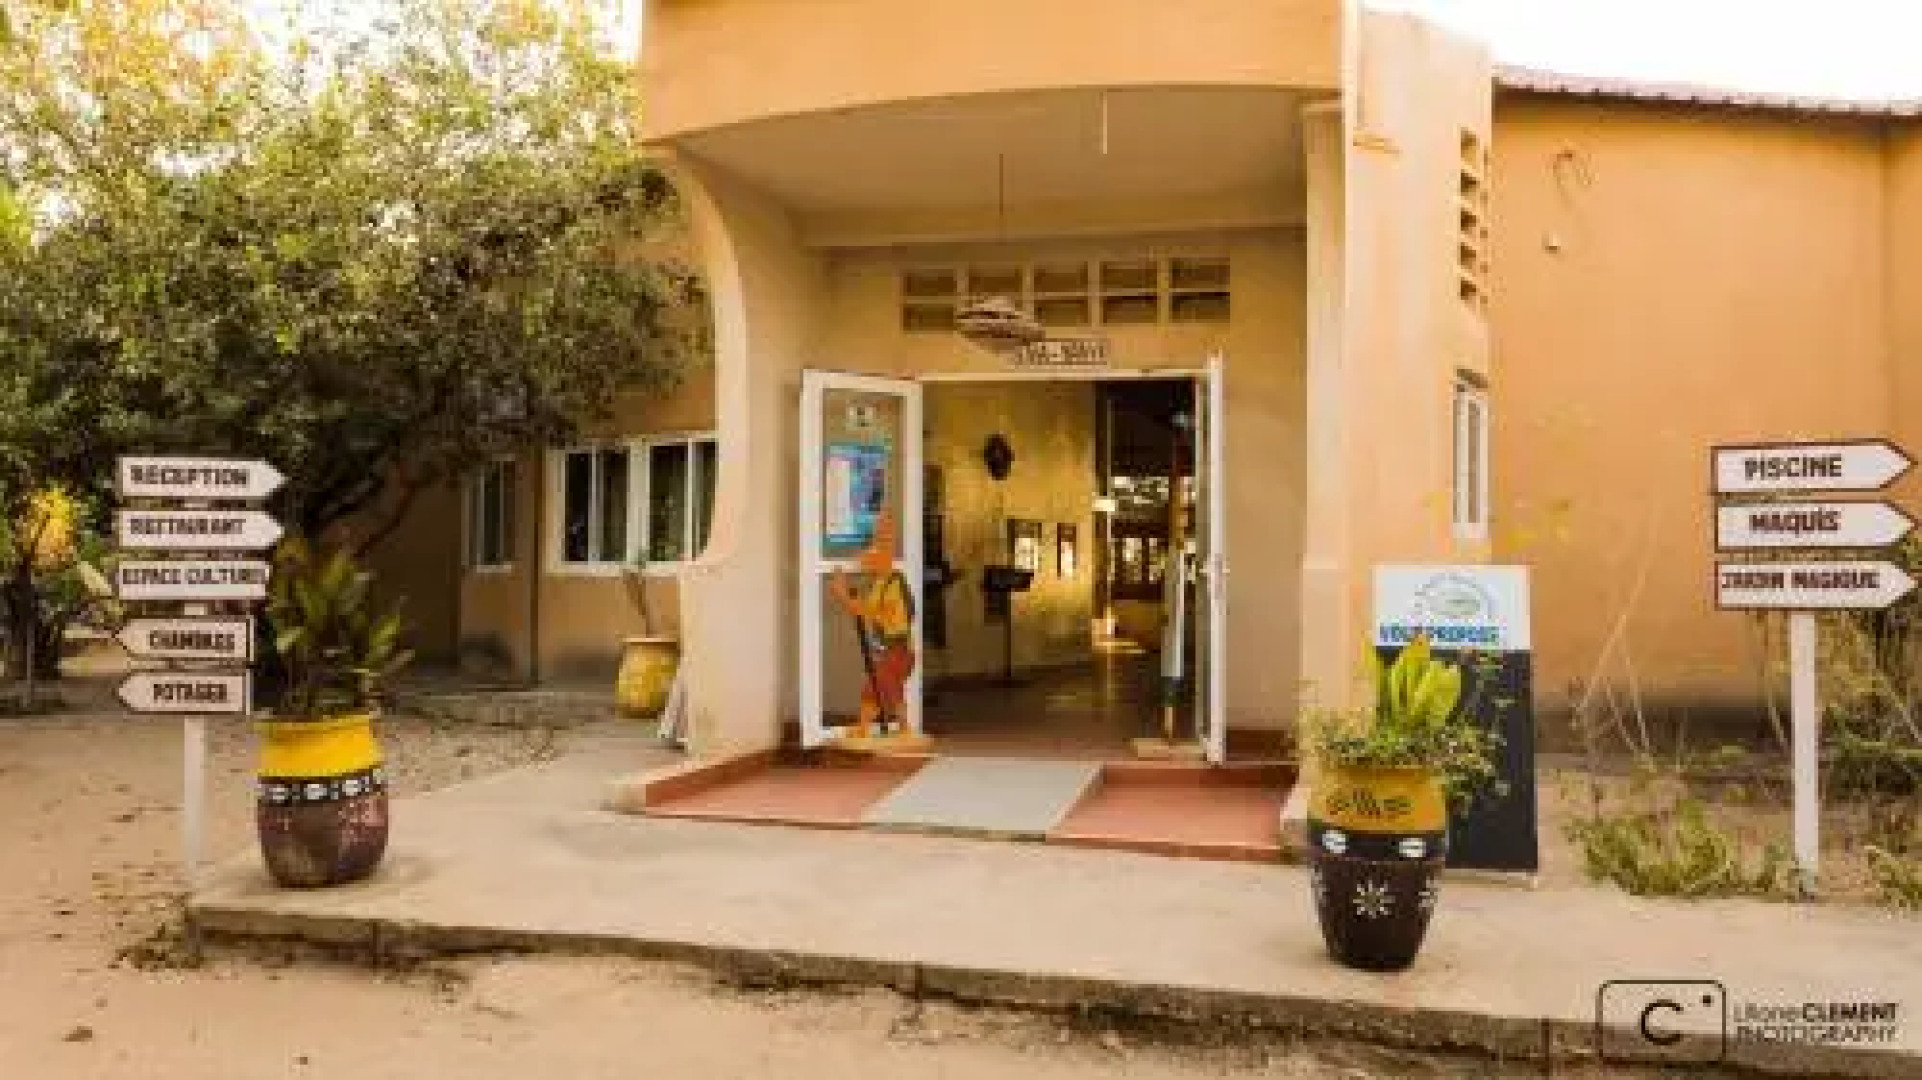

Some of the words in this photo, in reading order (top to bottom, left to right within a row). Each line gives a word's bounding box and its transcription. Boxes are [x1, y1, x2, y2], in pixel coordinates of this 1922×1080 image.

[1743, 454, 1843, 480] PISCINE
[130, 518, 247, 535] RESTAURANT
[122, 568, 181, 585] ESPACE
[1721, 572, 1785, 589] JARDIN
[1790, 571, 1881, 591] MAGIQUE
[148, 631, 235, 650] CHAMBRES
[153, 683, 228, 703] POTAGER
